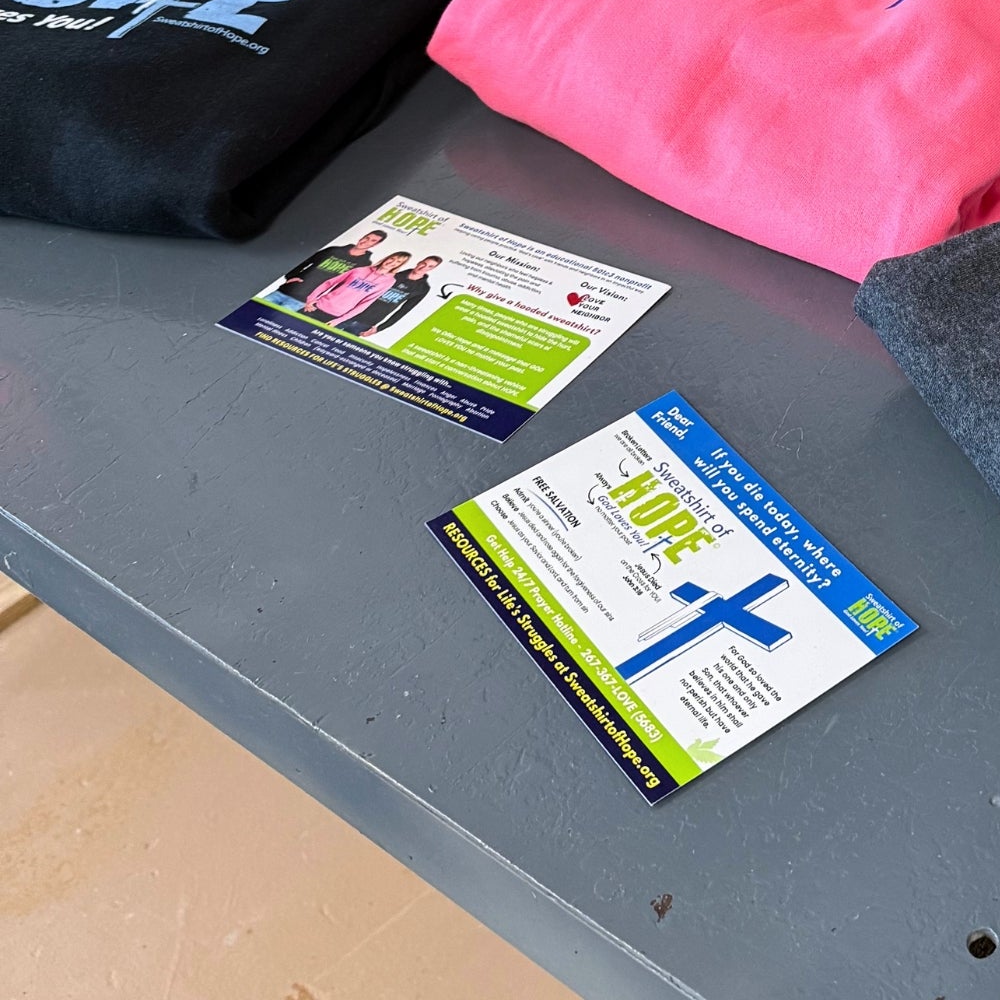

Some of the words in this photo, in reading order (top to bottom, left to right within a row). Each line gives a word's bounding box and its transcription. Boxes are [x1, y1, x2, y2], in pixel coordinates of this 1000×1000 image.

[33, 13, 115, 31] You!
[153, 15, 271, 56] SweatshirtofHope.org
[377, 207, 441, 236] HOPE
[395, 201, 438, 219] Sweatshirt
[459, 223, 500, 239] Sweatshirt
[505, 239, 527, 251] Hope
[545, 253, 594, 271] educational
[592, 267, 616, 278] 501c3
[614, 275, 652, 291] nonprofit
[488, 250, 506, 260] Our
[505, 256, 541, 272] Mission:
[467, 284, 487, 296] Why
[485, 293, 506, 302] give
[514, 301, 550, 317] hooded
[547, 315, 601, 335] sweatshirt?
[578, 301, 600, 312] YOUR
[580, 281, 598, 291] Our
[598, 287, 628, 302] Vision:
[570, 306, 611, 323] NEIGHBOR
[254, 331, 273, 341] FIND
[271, 337, 311, 357] RESOURCES
[308, 353, 325, 363] FOR
[322, 359, 345, 371] LIFE'S
[342, 367, 383, 386] STRUGGLES
[389, 386, 468, 422] SweatshirtofHope.org
[651, 410, 689, 440] Friend,
[667, 406, 694, 431] Dear
[710, 447, 728, 460] If
[718, 460, 745, 482] you
[594, 472, 612, 490] Always
[653, 462, 716, 524] Sweatshirt
[711, 523, 735, 538] of
[743, 483, 764, 501] die
[532, 475, 551, 493] FREE
[545, 491, 581, 528] SALVATION
[597, 495, 616, 511] God
[610, 509, 633, 531] Loves
[629, 529, 650, 547] You!
[609, 471, 714, 564] HOPE
[763, 501, 799, 540] today,
[694, 456, 721, 479] will
[711, 479, 739, 501] you
[737, 502, 777, 536] spend
[772, 537, 831, 589] eternity?
[634, 563, 651, 579] Jesus
[647, 576, 663, 591] Died
[803, 539, 841, 577] where
[622, 575, 635, 589] John
[848, 597, 897, 640] HOPE
[865, 593, 896, 623] Sweatshirt
[892, 621, 905, 630] of
[443, 522, 492, 577] RESOURCES
[484, 574, 502, 591] for
[496, 589, 522, 616] Life's
[516, 614, 558, 662] Struggles
[554, 661, 570, 675] at
[564, 672, 660, 788] SweatshirtofHope.org
[485, 534, 502, 551] Get
[497, 548, 515, 568] Help
[512, 566, 536, 587] 24/7
[529, 586, 555, 615] Prayer
[551, 613, 578, 645] Hotline
[580, 648, 638, 712] 267-367-LOVE
[630, 710, 663, 743] (5683)
[701, 667, 714, 682] Son,
[712, 679, 728, 694] that
[724, 692, 750, 718] whoever
[713, 662, 724, 674] his
[721, 672, 735, 685] one
[732, 683, 747, 697] and
[743, 695, 758, 710] only
[720, 654, 739, 672] world
[735, 669, 750, 684] that
[745, 681, 756, 692] he
[752, 690, 770, 706] gave
[728, 645, 740, 656] For
[737, 655, 752, 669] God
[748, 667, 758, 676] so
[755, 673, 774, 692] loved
[770, 690, 782, 702] the
[679, 678, 692, 690] not
[686, 688, 708, 709] perish
[705, 705, 718, 719] but
[714, 716, 731, 734] have
[679, 696, 702, 718] eternal
[697, 715, 709, 729] life.
[688, 670, 713, 696] believes
[709, 693, 718, 702] in
[715, 699, 729, 714] him
[726, 712, 744, 728] shall
